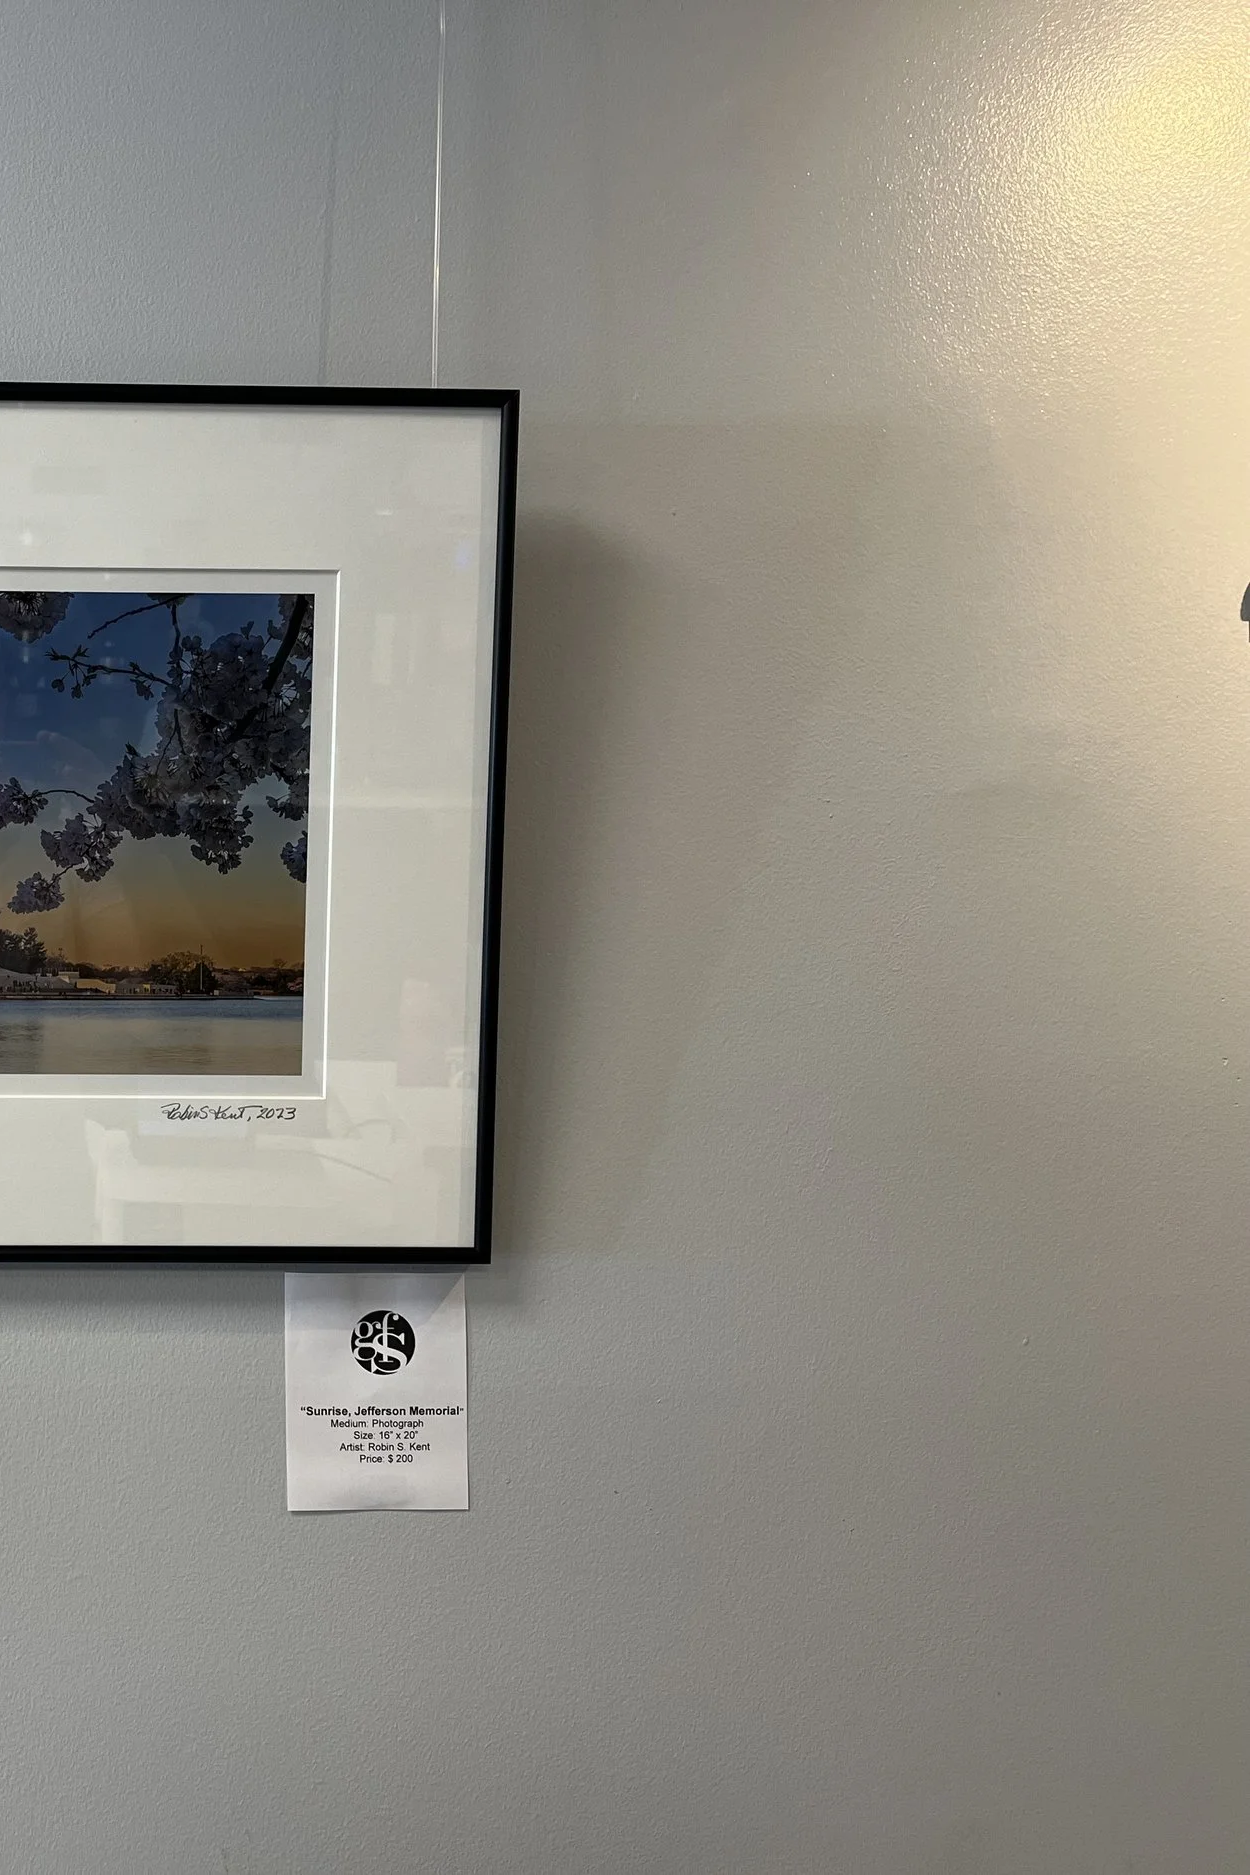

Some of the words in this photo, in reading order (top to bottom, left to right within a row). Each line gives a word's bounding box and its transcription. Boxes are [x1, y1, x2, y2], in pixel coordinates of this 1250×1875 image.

[256, 1107, 297, 1120] 2023
[354, 1406, 406, 1416] Jefferson
[330, 1419, 369, 1428] Medium:
[372, 1419, 424, 1430] Photograph
[353, 1431, 376, 1440] Size:
[340, 1442, 365, 1451] Artist:
[368, 1442, 395, 1451] Robin
[397, 1442, 406, 1451] S.
[409, 1442, 431, 1451] Kent
[359, 1454, 385, 1463] Price:
[396, 1454, 414, 1463] 200
